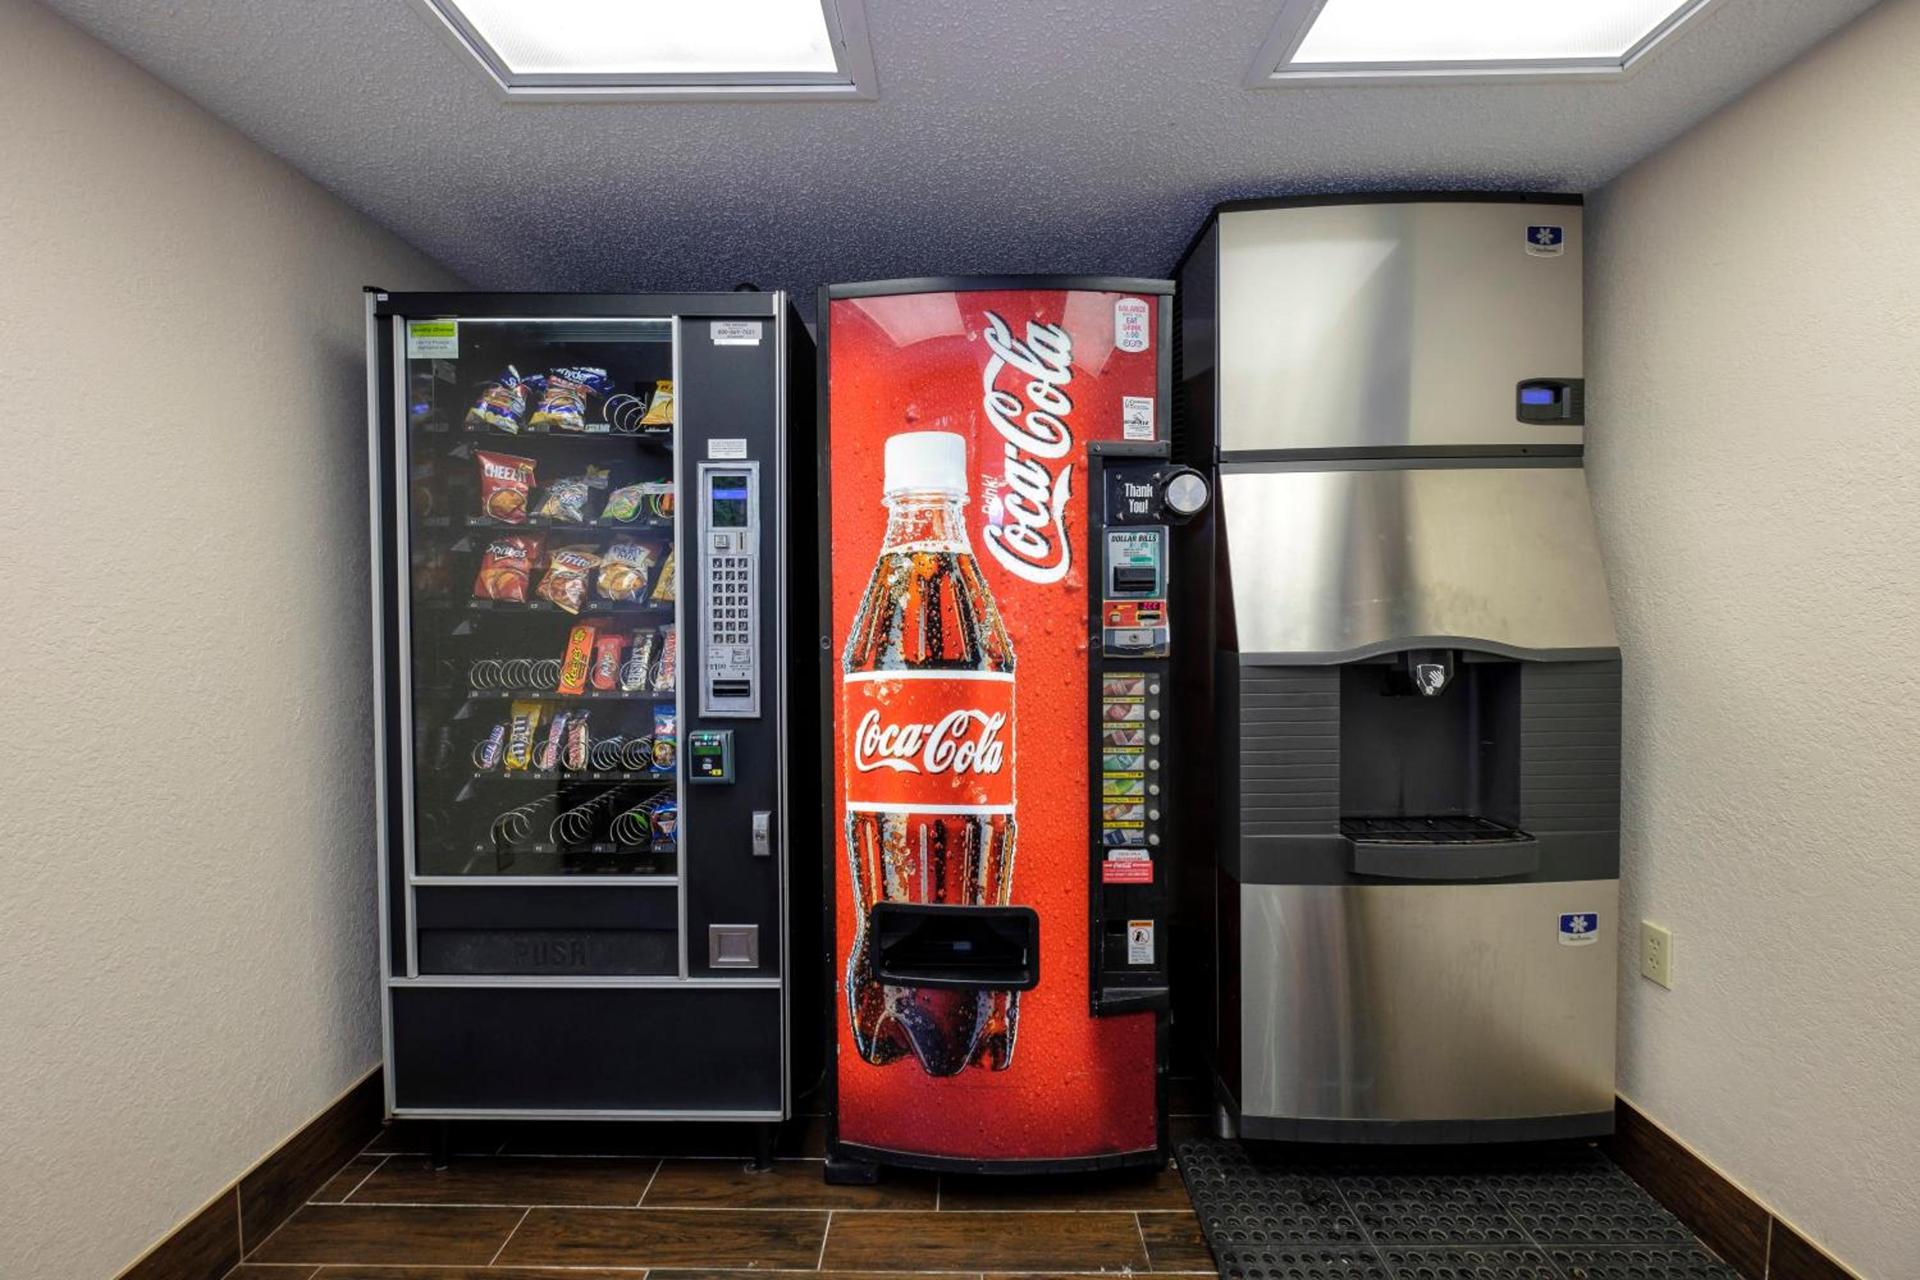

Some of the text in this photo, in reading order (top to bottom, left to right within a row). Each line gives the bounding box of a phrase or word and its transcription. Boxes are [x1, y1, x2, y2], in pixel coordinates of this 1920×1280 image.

[983, 311, 1073, 584] Coca-Cola
[981, 474, 999, 515] Drink!
[1124, 483, 1153, 497] Thank
[1128, 499, 1149, 513] You!
[1138, 534, 1157, 542] BILLS
[855, 709, 1007, 774] Coca-Cola
